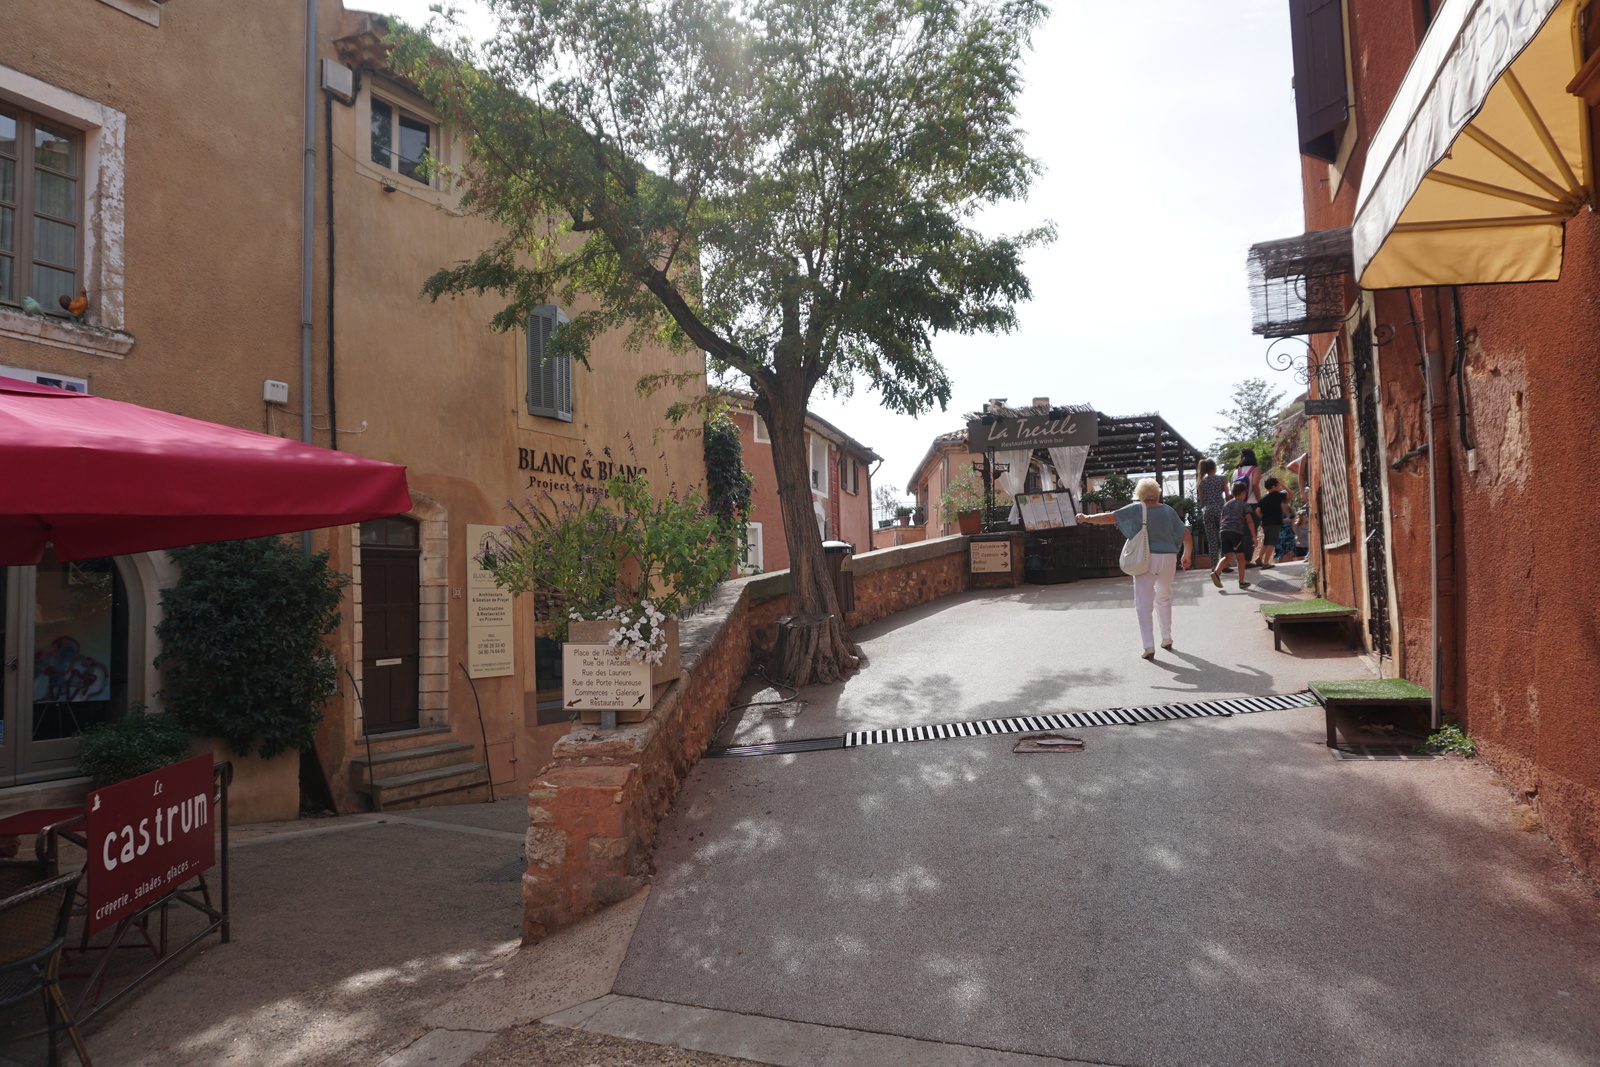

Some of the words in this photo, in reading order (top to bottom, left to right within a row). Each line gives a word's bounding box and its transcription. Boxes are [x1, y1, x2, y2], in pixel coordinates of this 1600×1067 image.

[988, 421, 1008, 440] La
[1016, 415, 1078, 439] Treille
[518, 447, 576, 476] BLANC
[580, 459, 594, 480] &
[526, 476, 569, 492] Project
[153, 780, 163, 796] Le
[103, 793, 208, 871] castrum
[134, 876, 162, 900] salades
[166, 860, 188, 883] glaces
